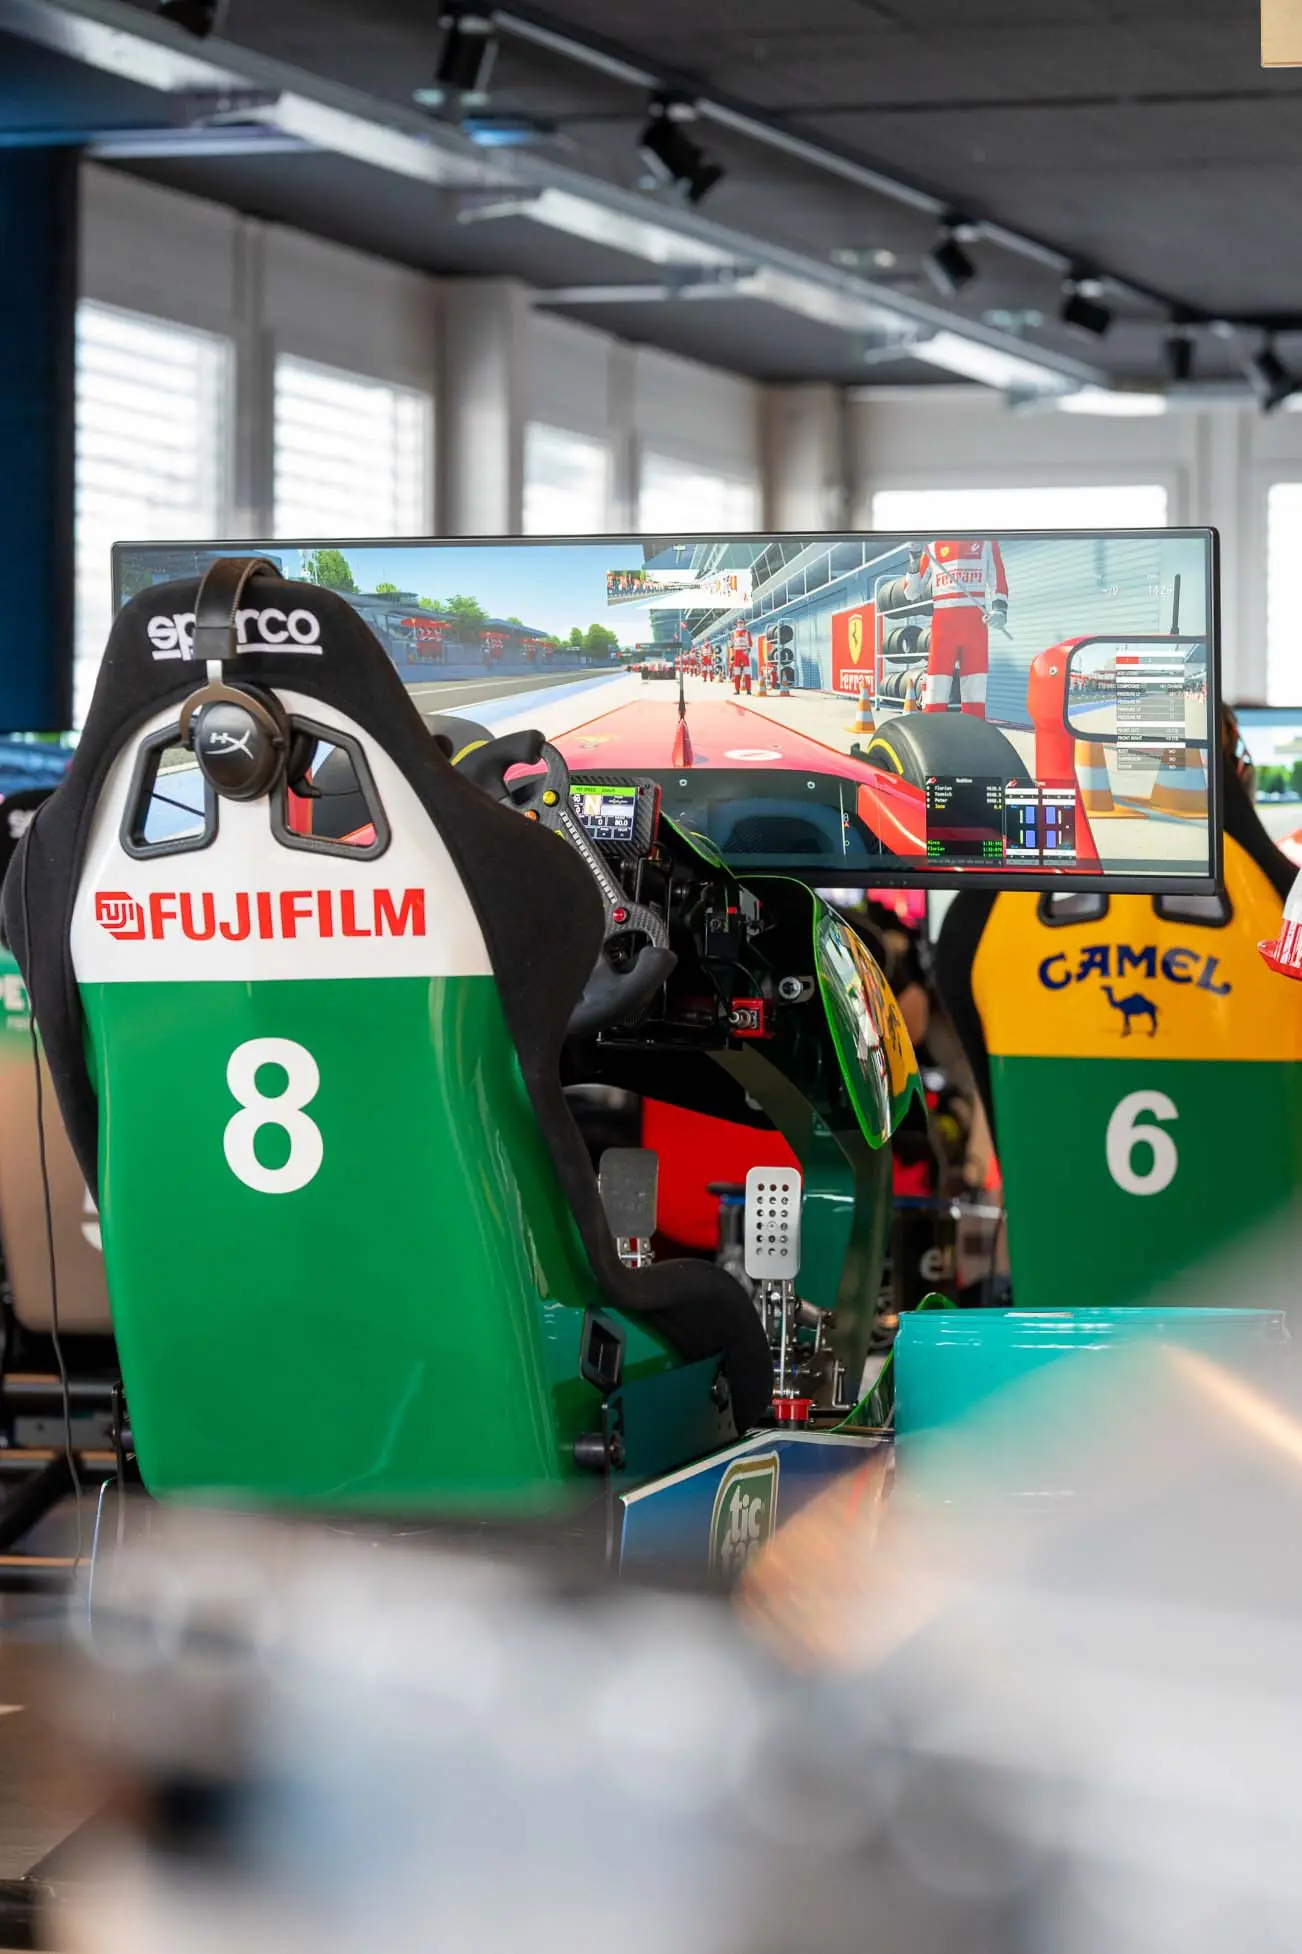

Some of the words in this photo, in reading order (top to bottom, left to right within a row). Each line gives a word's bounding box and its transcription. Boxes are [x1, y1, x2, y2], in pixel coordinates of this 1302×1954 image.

[147, 608, 323, 661] sprco
[149, 889, 426, 940] FUJIFILM
[1038, 944, 1232, 996] CAMEL
[223, 1037, 324, 1194] 8
[1105, 1089, 1179, 1196] 6
[730, 1485, 762, 1542] tic
